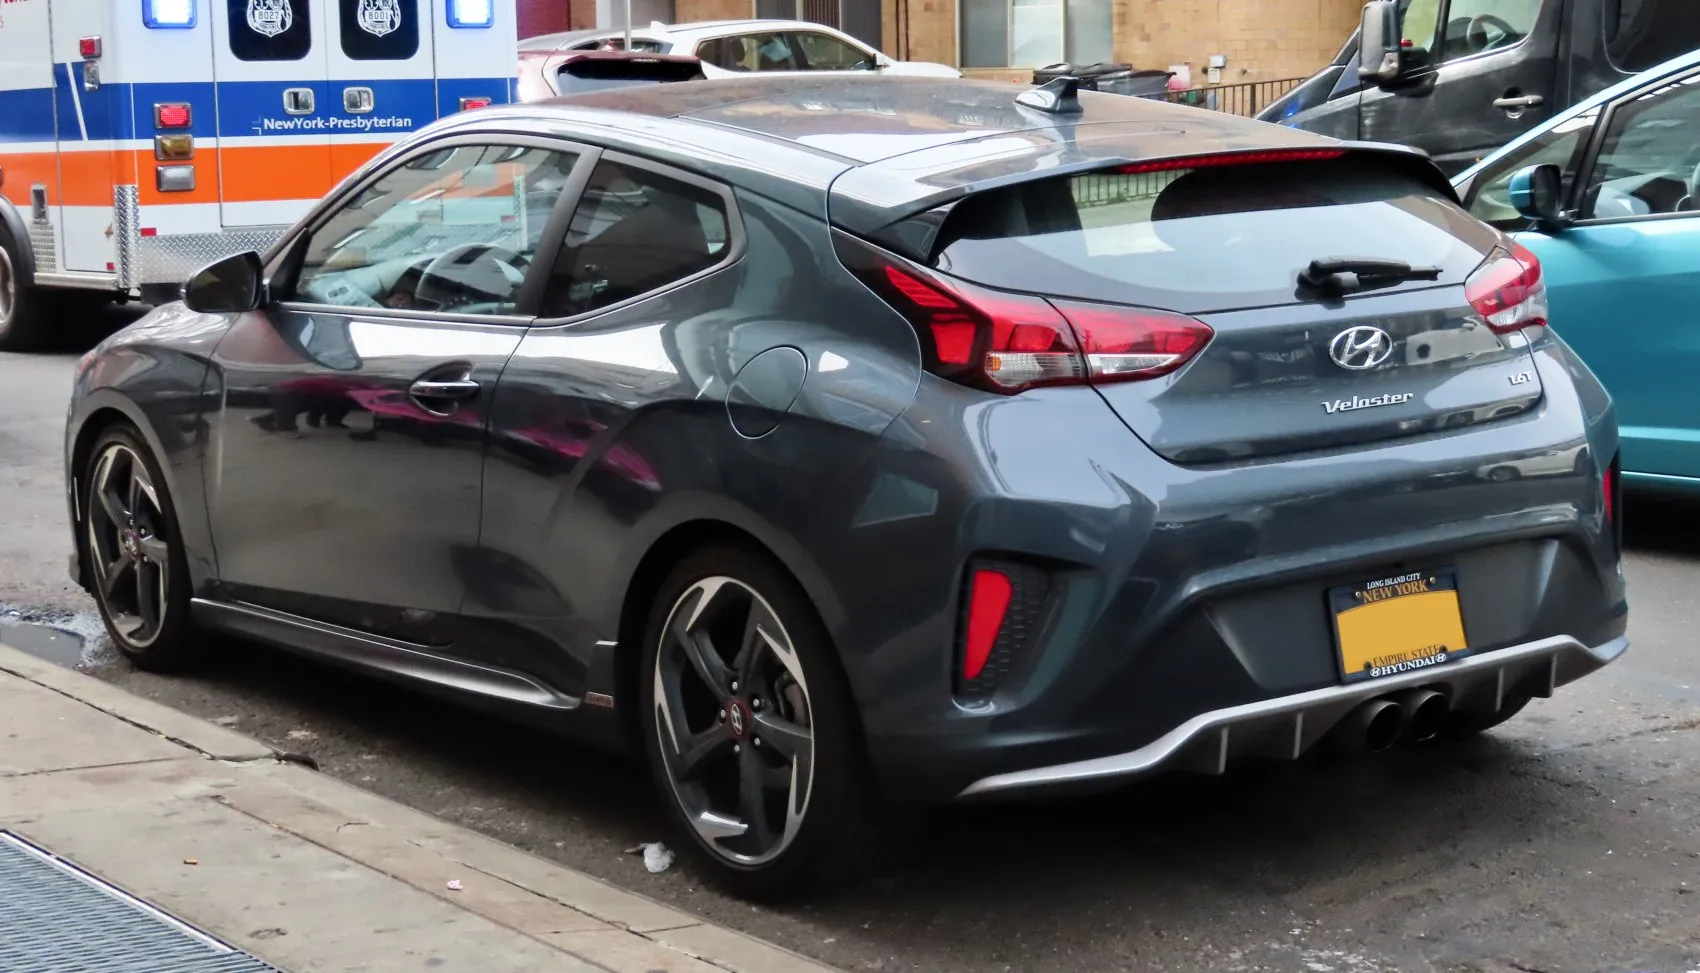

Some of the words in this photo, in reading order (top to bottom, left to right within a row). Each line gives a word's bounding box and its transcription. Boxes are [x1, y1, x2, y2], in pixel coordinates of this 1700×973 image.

[368, 11, 389, 20] 8001
[264, 116, 412, 131] NewYork-Presbyterian
[1321, 392, 1414, 413] Veloster
[1362, 586, 1392, 604] NEW
[1394, 579, 1428, 596] YORK
[1367, 579, 1385, 590] LONG
[1385, 575, 1406, 586] ISLAND
[1406, 572, 1421, 582] CITY
[1373, 652, 1409, 667] EMPIRE
[1411, 644, 1439, 660] STATE
[1381, 655, 1436, 676] HYUNDAI
